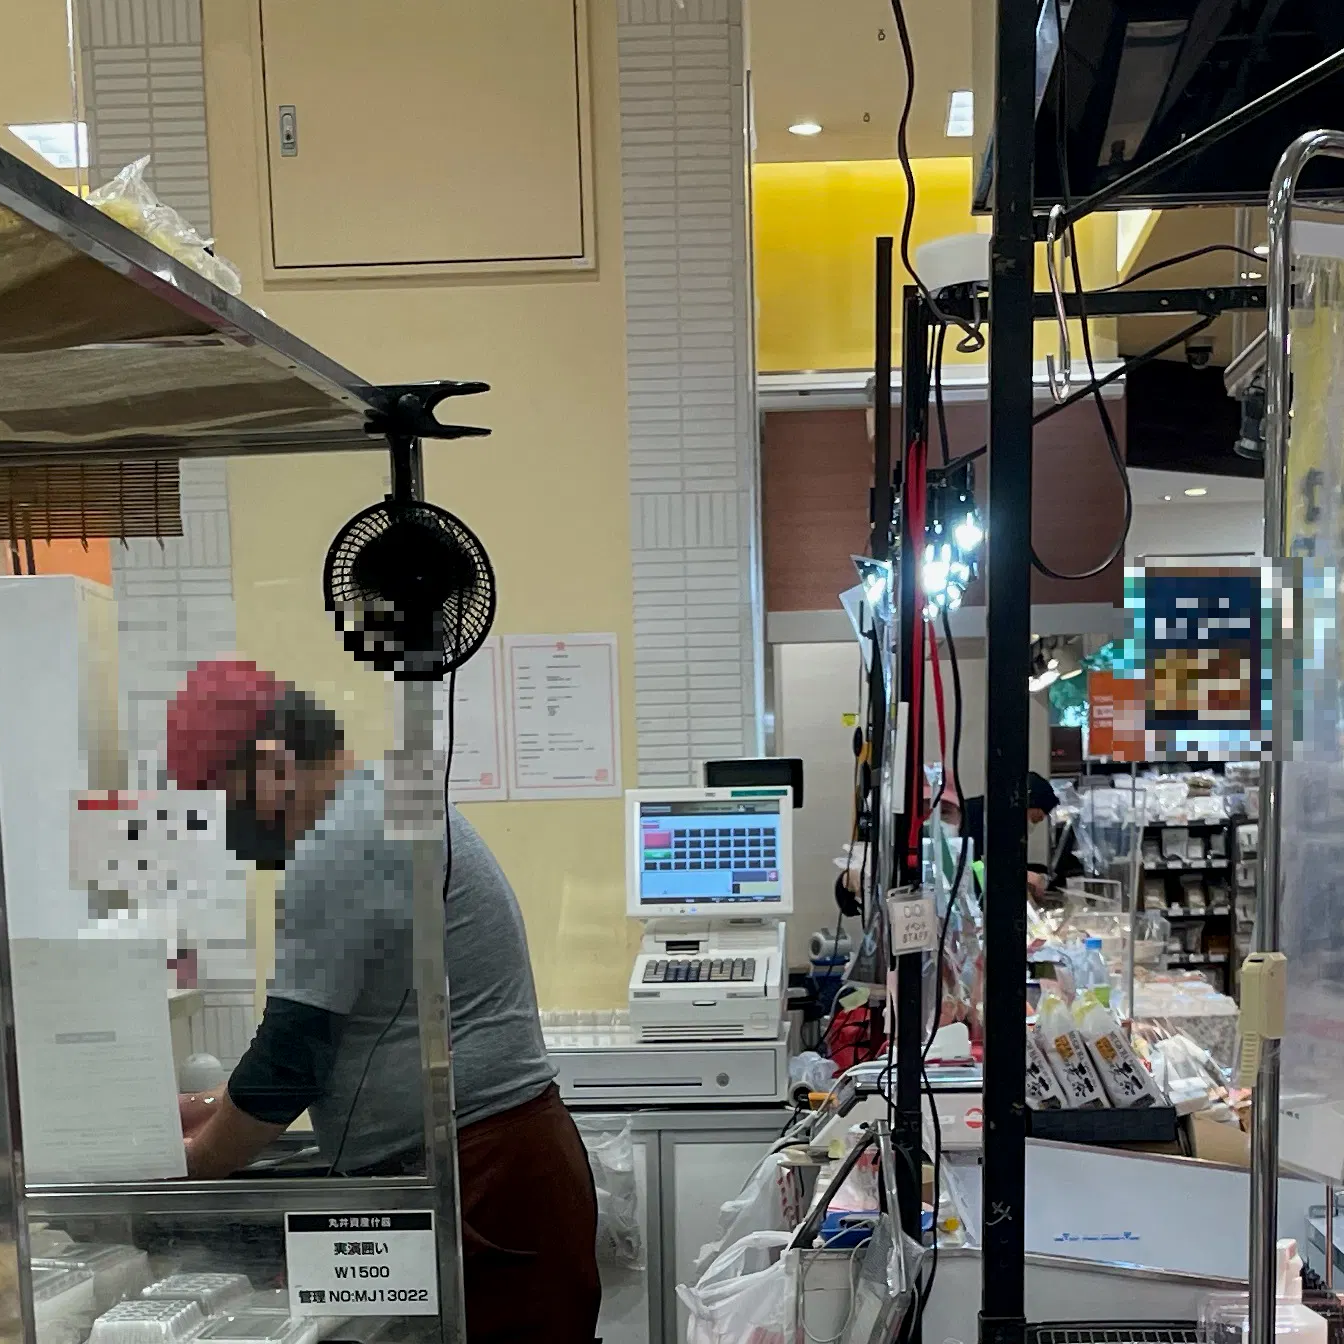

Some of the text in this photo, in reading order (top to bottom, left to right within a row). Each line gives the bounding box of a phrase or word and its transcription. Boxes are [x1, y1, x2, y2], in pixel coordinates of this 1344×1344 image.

[328, 1216, 392, 1228] 丸井資産什器
[333, 1241, 389, 1256] 実演囲い
[334, 1265, 390, 1279] W1500
